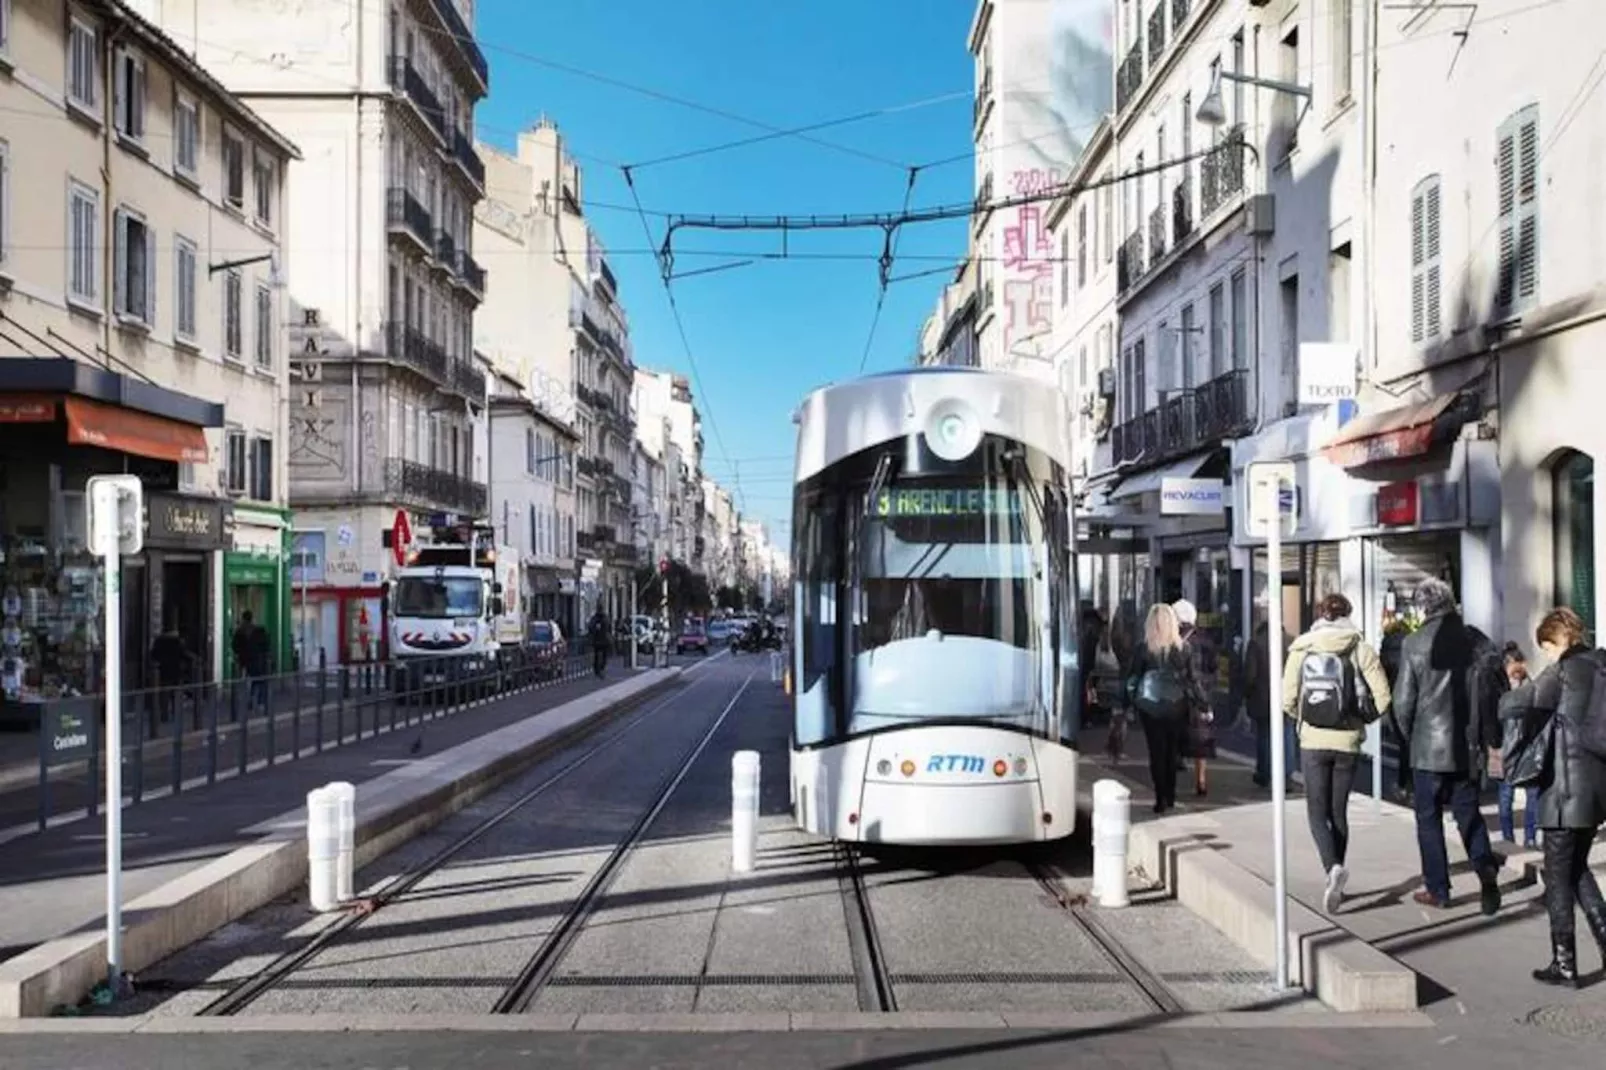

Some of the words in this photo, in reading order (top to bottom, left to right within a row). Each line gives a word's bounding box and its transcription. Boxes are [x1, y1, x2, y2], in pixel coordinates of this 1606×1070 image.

[304, 308, 318, 434] RAVIX
[1308, 384, 1352, 397] TEXTO
[926, 754, 985, 773] RTM
